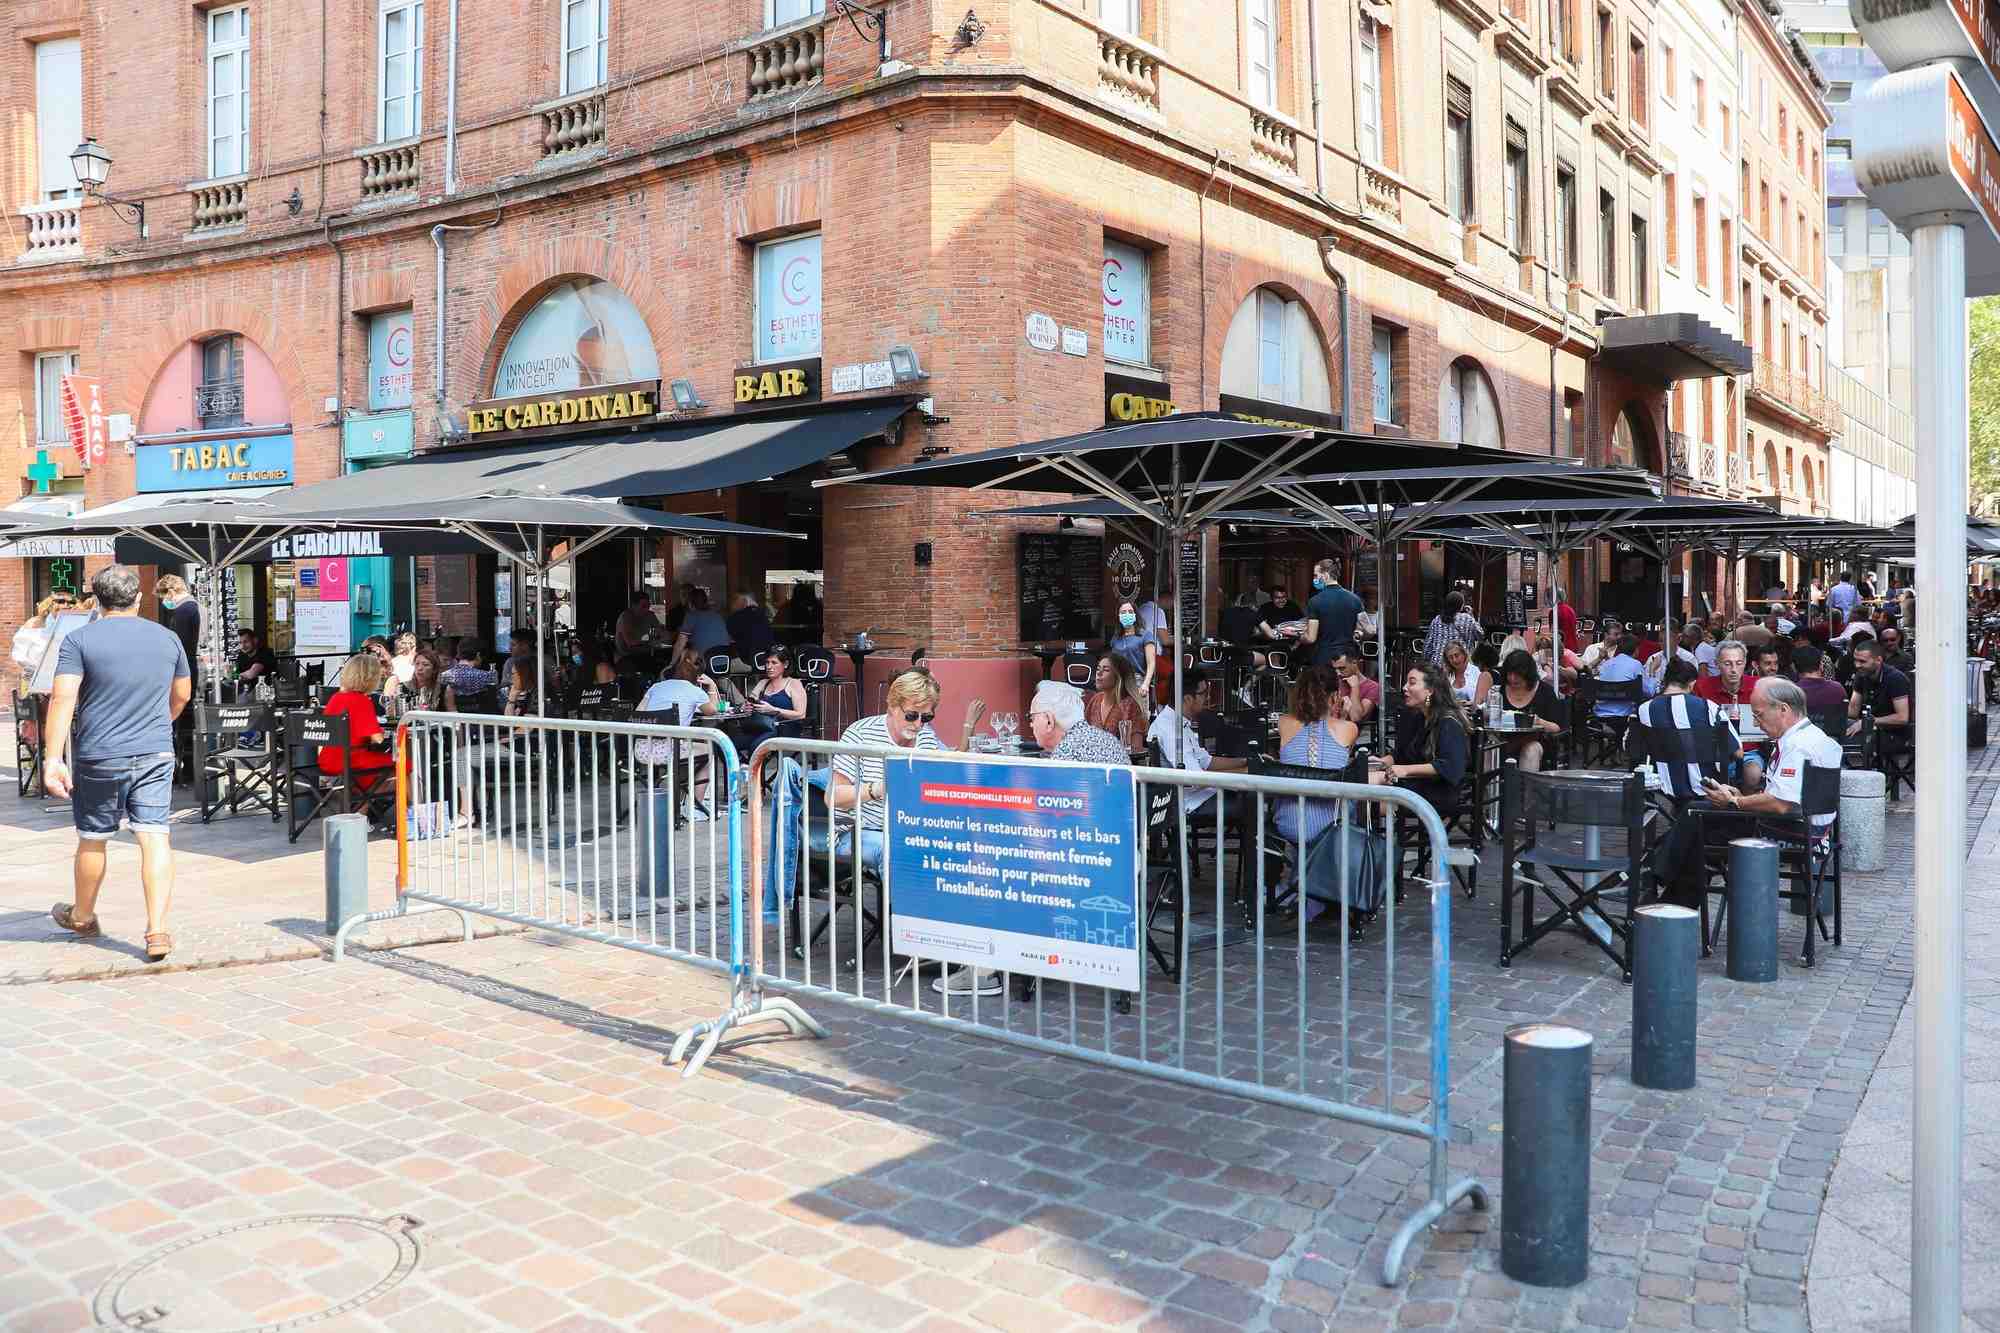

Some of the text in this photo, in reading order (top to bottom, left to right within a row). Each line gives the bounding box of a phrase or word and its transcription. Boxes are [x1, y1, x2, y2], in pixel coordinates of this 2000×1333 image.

[506, 355, 570, 377] INNOVATION
[506, 373, 556, 391] MINCEUR
[735, 369, 808, 402] BAR
[89, 384, 105, 457] TABAC
[467, 390, 652, 434] LE CARDINAL
[168, 443, 250, 471] TABAC
[60, 539, 74, 554] LE
[272, 531, 384, 557] LE CARDINAL
[218, 708, 250, 718] Vincent
[304, 719, 326, 729] Sophie
[1038, 795, 1083, 809] COVID-19
[898, 810, 1121, 845] Pour soutenir les restaurateurs et les bars
[904, 835, 1112, 867] cette voie est temporairement fermée
[922, 856, 1091, 888] à la circulation pour permettre
[1005, 887, 1019, 902] de
[1021, 889, 1075, 908] terrasses.
